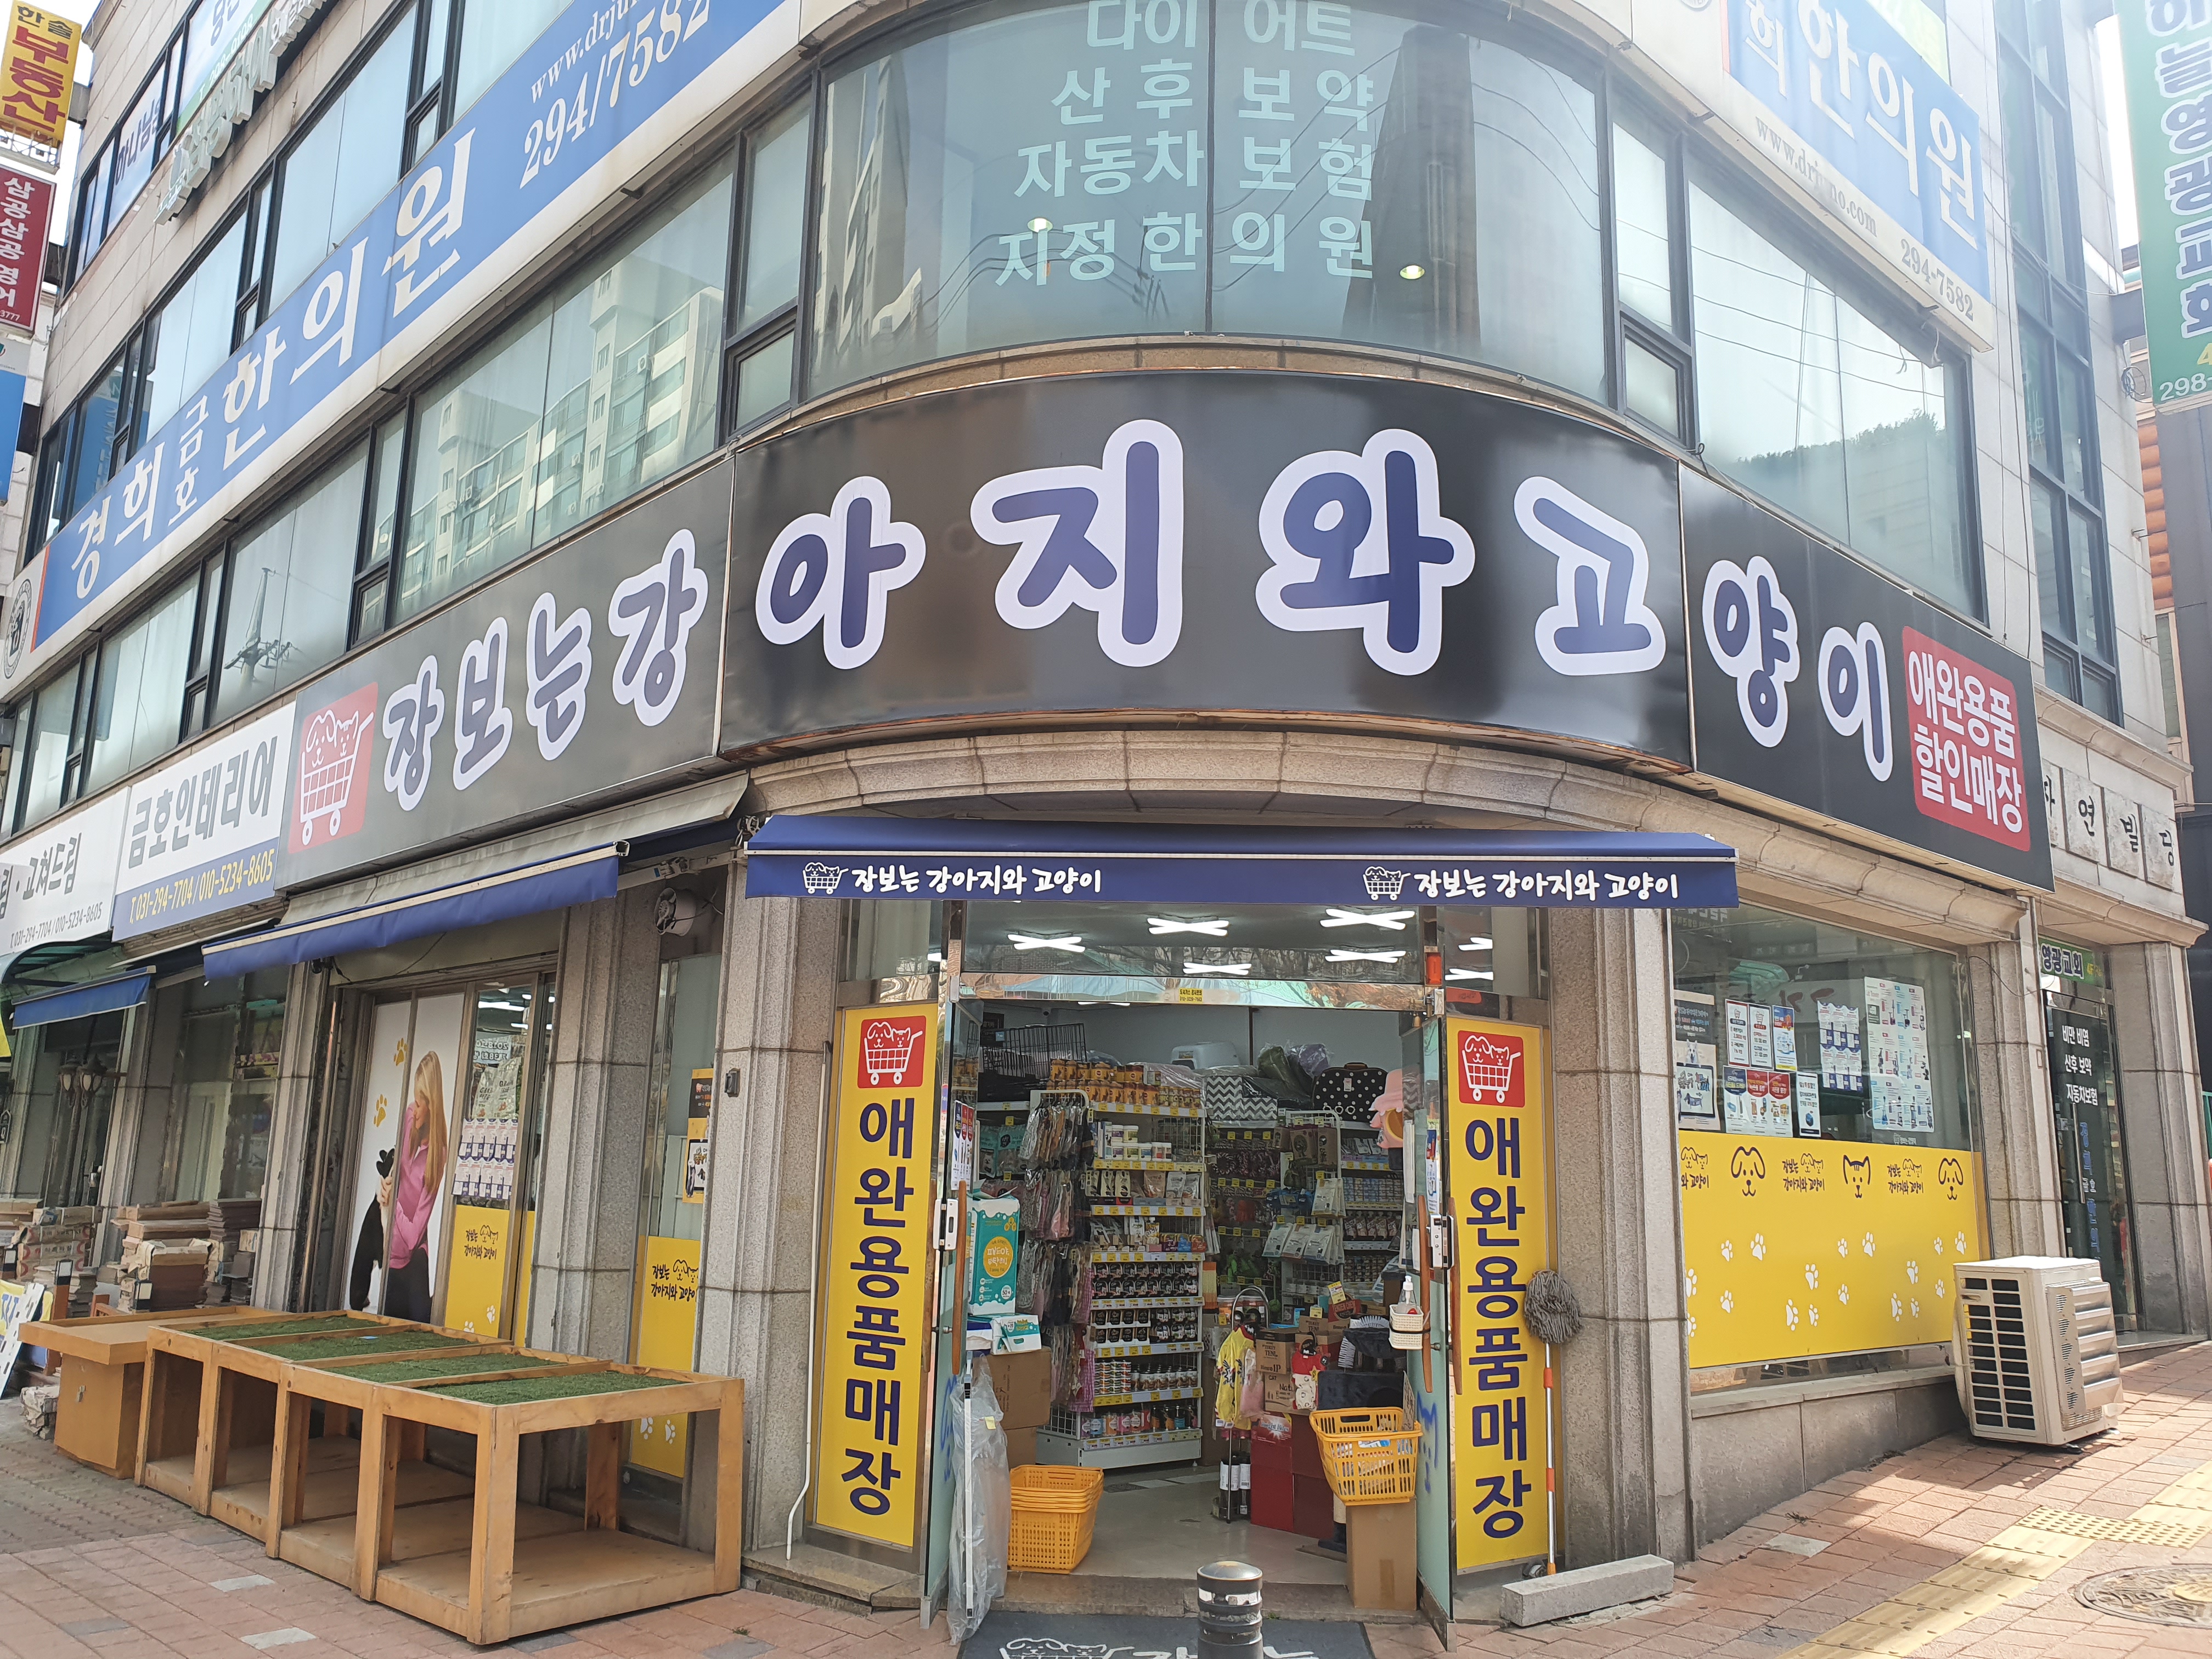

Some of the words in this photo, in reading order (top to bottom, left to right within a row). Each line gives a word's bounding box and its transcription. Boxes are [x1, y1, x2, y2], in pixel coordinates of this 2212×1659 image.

[17, 5, 73, 40] 한솔
[531, 0, 639, 103] www.drju
[2, 25, 69, 132] 부동산
[1051, 58, 1193, 125] 산후
[1238, 66, 1374, 132] 보약
[1013, 130, 1204, 198] 자동차
[1239, 136, 1373, 201] 보험
[995, 218, 1116, 286] 지정
[1142, 211, 1373, 279] 한의원
[1900, 239, 1973, 322] 294-7582
[222, 127, 476, 471] 한의원
[382, 591, 592, 812] 장보는
[1909, 650, 2016, 760] 애완용품
[128, 736, 278, 870] 금호인테리어
[1914, 730, 2023, 834] 할인매장
[851, 865, 920, 894] 장보는
[926, 865, 1027, 895] 강아지와
[1032, 867, 1101, 894] 고양이
[1414, 870, 1487, 899] 장보는
[1492, 870, 1600, 901] 강아지와
[1604, 872, 1678, 900] 고양이
[2062, 1025, 2075, 1045] 비만
[2079, 1058, 2092, 1076] 보약
[1690, 1174, 1709, 1189] 고양이
[1782, 1160, 1798, 1173] 장보는
[1783, 1178, 1808, 1193] 강아지와
[1809, 1177, 1825, 1192] 고양이
[1887, 1164, 1901, 1178] 장보는
[1889, 1181, 1910, 1195] 강아지와
[1911, 1181, 1924, 1194] 고양이
[651, 1282, 678, 1301] 강아지와
[679, 1286, 697, 1303] 고양이
[652, 1264, 669, 1280] 장보는
[841, 1098, 915, 1516] 애완용품매장
[1464, 1118, 1532, 1539] 애완용품매장
